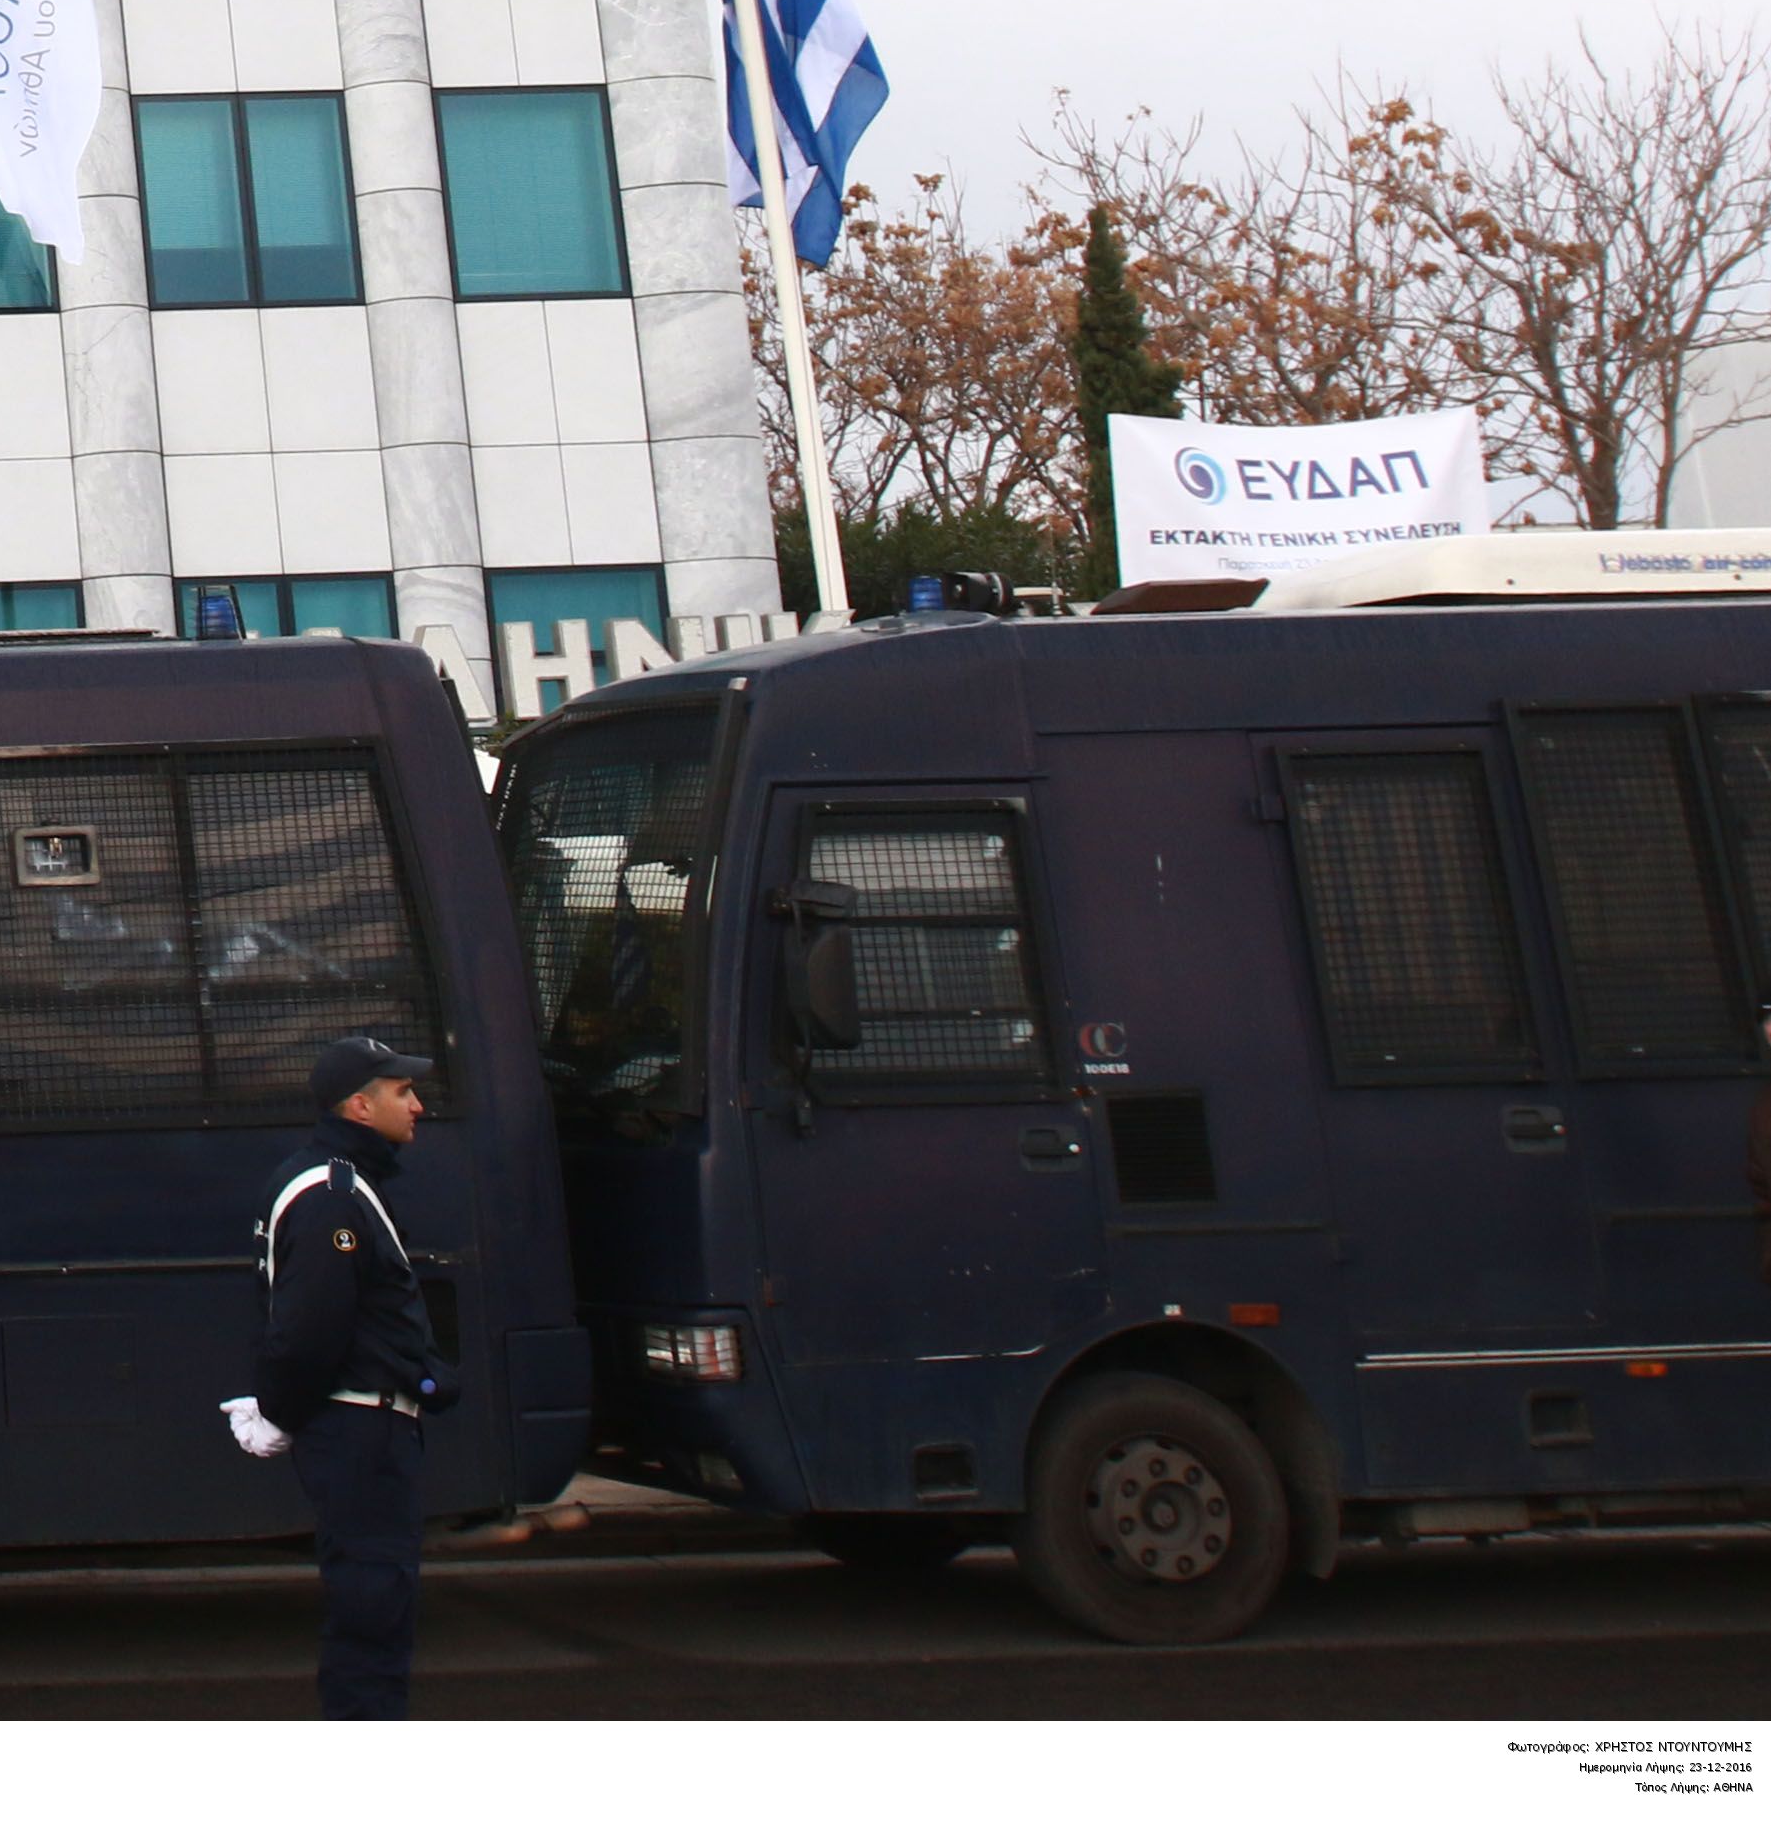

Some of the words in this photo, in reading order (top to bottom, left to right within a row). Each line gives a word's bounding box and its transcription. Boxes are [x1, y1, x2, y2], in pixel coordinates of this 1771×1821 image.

[1236, 450, 1431, 501] ΕΥΔΑΠ
[1150, 528, 1251, 548] ΕΚΤΑΚΤΗ
[1257, 531, 1337, 548] ΓΕΝΙΚΗ
